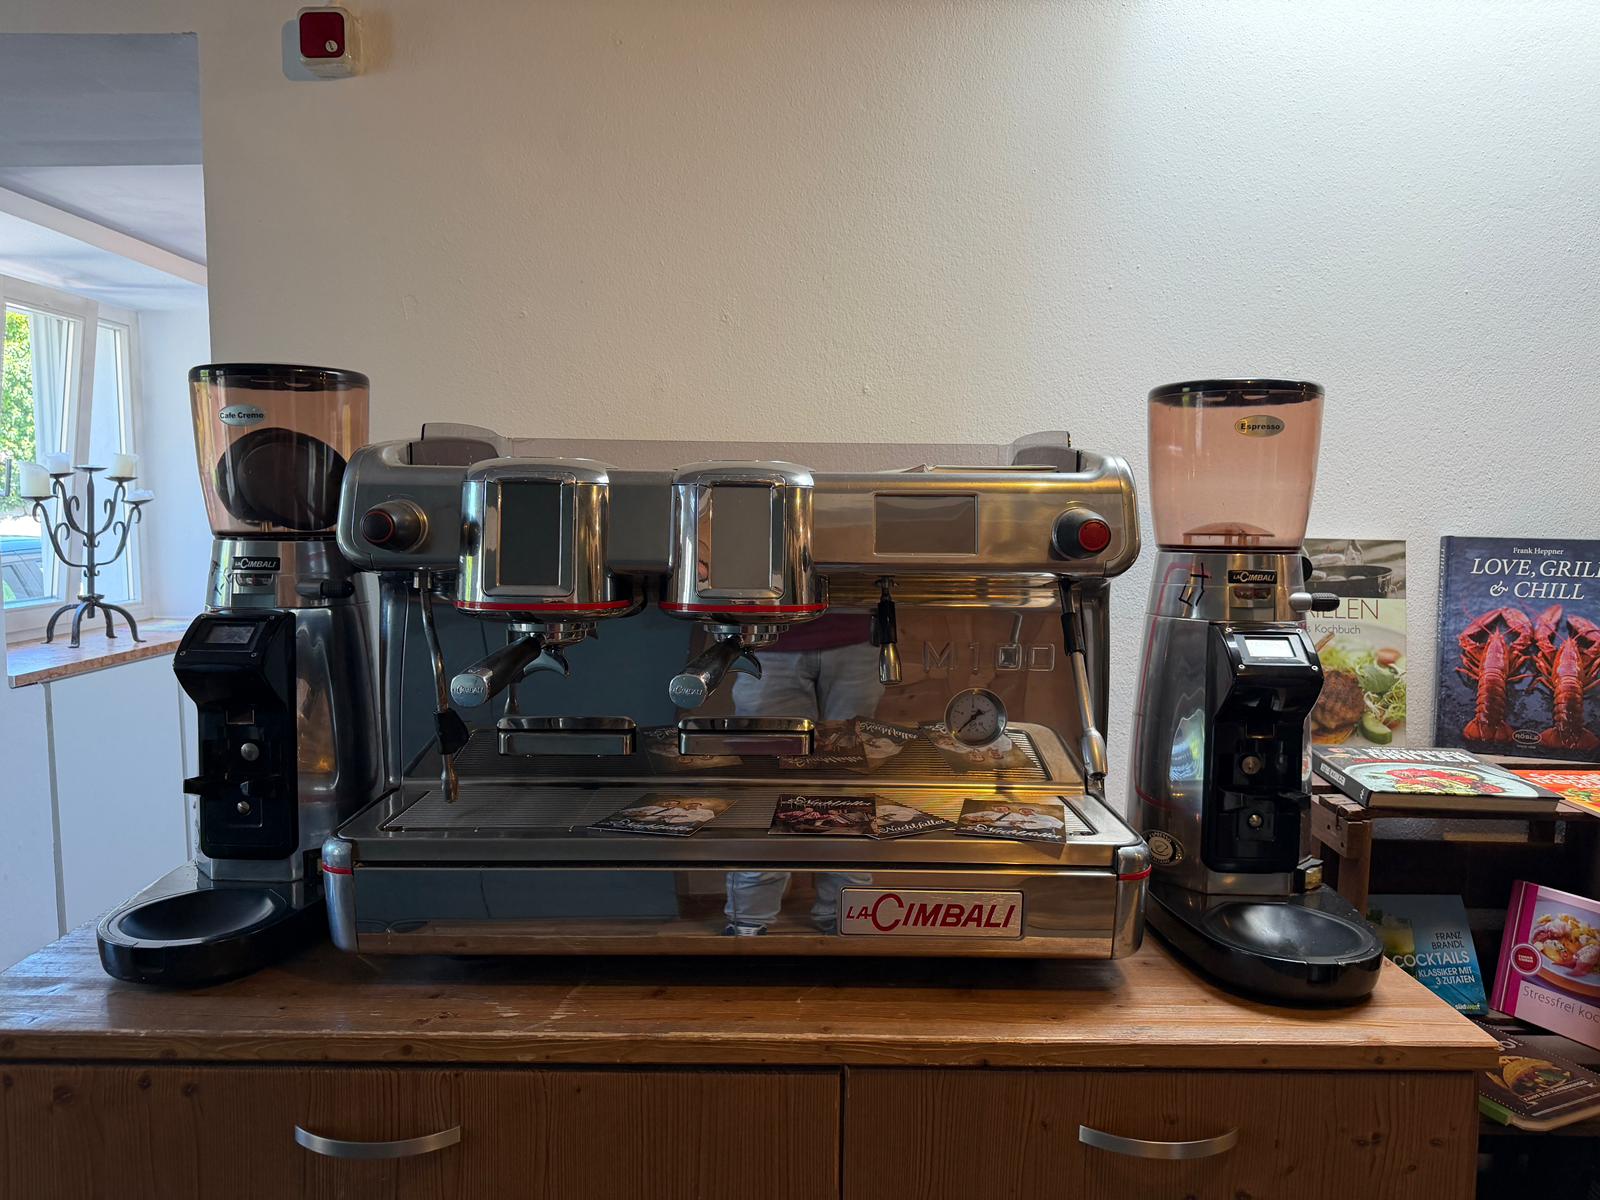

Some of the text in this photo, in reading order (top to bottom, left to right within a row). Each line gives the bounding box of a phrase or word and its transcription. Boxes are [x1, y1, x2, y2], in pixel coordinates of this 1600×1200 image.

[1241, 423, 1280, 431] Espresso
[1513, 547, 1564, 556] Frank Heppner
[240, 558, 276, 569] CIMBALI
[1470, 558, 1536, 577] LOVE,
[1240, 571, 1274, 582] CIMBALI
[1489, 580, 1584, 600] & CHILL
[1314, 624, 1360, 634] Kochbuch
[846, 893, 1016, 932] LA CIMBALI
[1436, 931, 1462, 940] FRANZ
[1431, 940, 1465, 950] BRANDL
[1392, 951, 1470, 967] COCKTAILS
[1417, 967, 1473, 978] KLASSIKER MIT
[1435, 975, 1476, 985] 3 ZUTATEN
[1523, 985, 1575, 1013] Stressfrei
